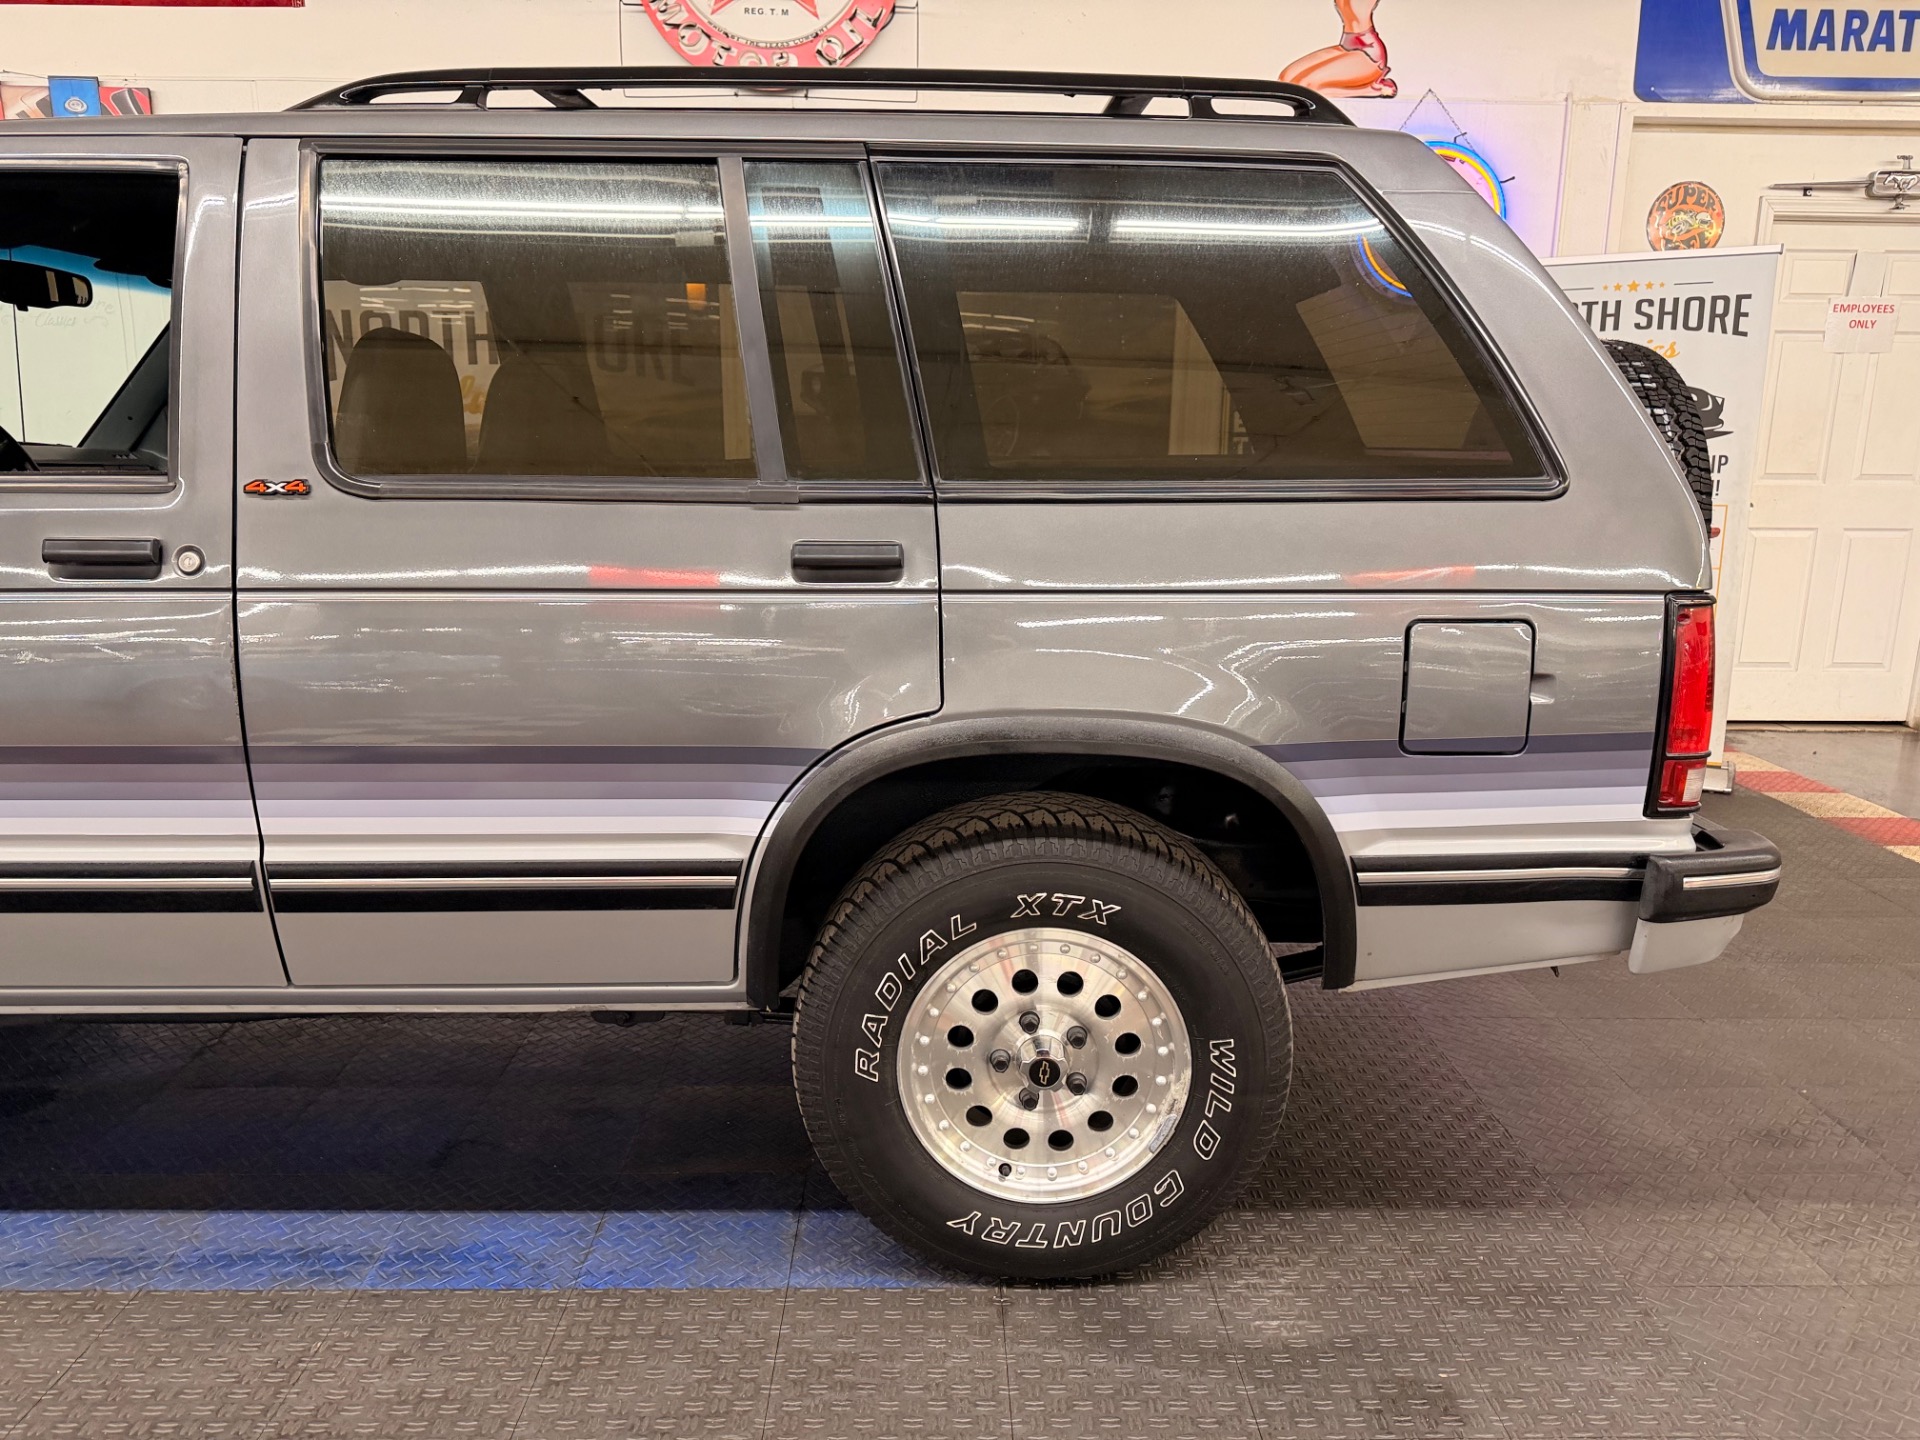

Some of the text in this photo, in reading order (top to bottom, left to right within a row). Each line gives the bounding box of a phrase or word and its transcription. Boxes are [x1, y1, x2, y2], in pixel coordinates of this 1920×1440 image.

[815, 6, 888, 66] OIL
[1656, 185, 1717, 217] SUPER
[1633, 293, 1752, 337] SHORE
[1832, 303, 1896, 314] EMPLOYEES
[1848, 319, 1877, 329] ONLY
[855, 892, 1121, 1083] RADIAL XTX
[1193, 1038, 1237, 1161] WILD
[946, 1169, 1185, 1249] COUNTRY
